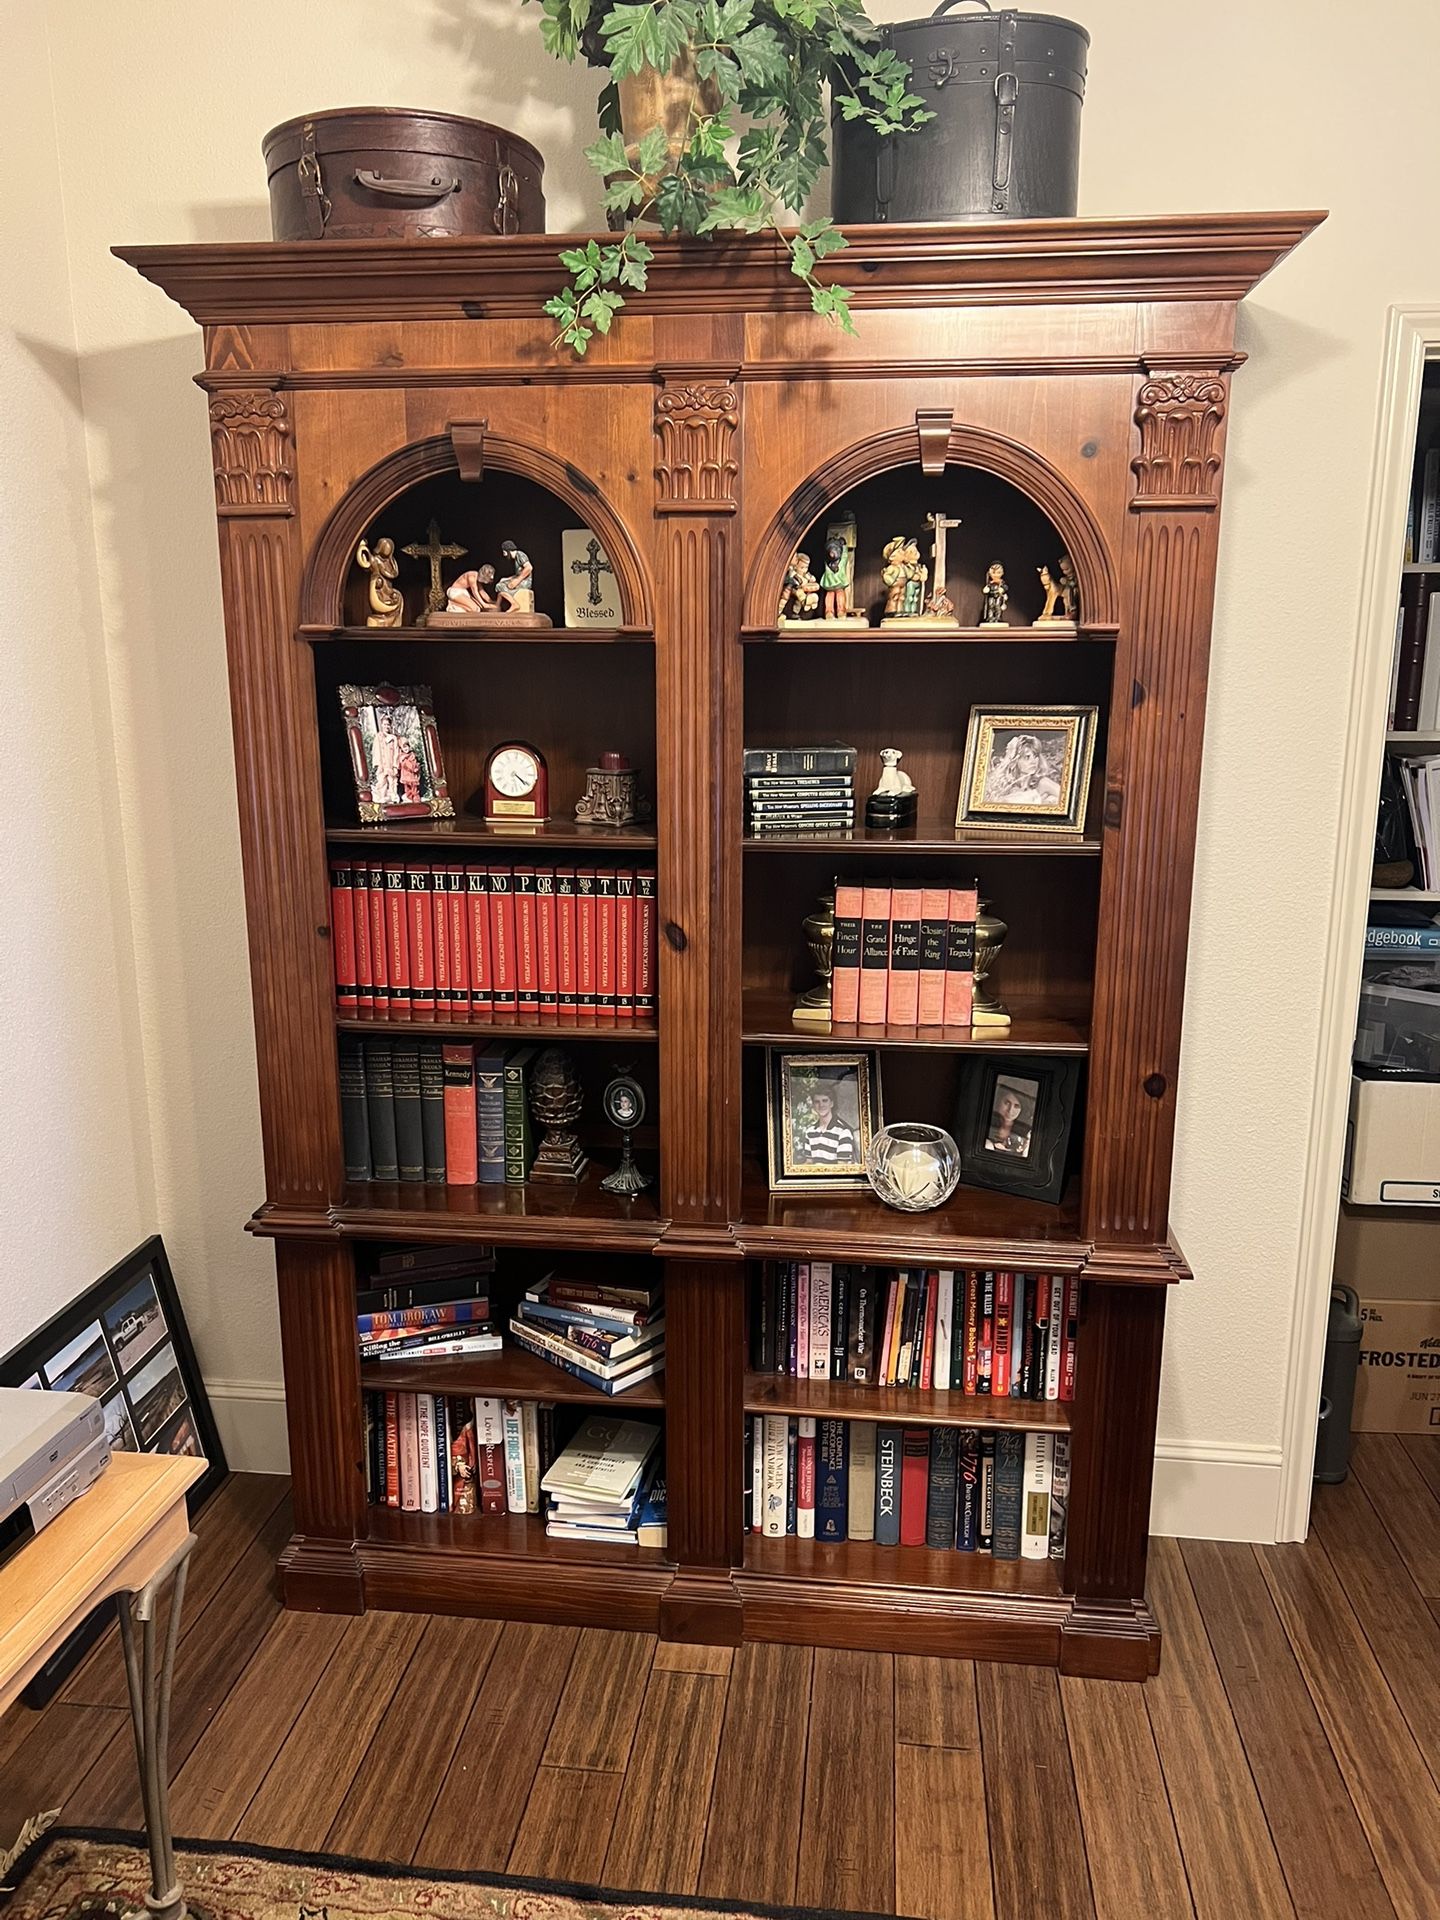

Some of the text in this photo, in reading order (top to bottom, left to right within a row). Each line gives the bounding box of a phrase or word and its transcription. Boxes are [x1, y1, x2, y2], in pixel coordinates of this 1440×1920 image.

[576, 606, 615, 618] Blessed
[337, 872, 346, 886] B
[388, 874, 402, 888] DE
[411, 875, 424, 890] FG
[435, 875, 444, 890] H
[469, 876, 484, 891] KL
[492, 877, 507, 891] NO
[521, 877, 530, 891] P
[538, 878, 552, 893] QR
[601, 880, 610, 894] T
[617, 880, 632, 895] UV
[836, 932, 859, 942] Finest
[922, 926, 946, 936] Closing
[950, 925, 974, 935] Triumph
[866, 935, 886, 944] Grand
[894, 935, 917, 944] Hinge
[837, 946, 856, 954] Hour
[864, 947, 888, 956] Alliance
[893, 946, 918, 956] of Fate
[925, 950, 941, 960] Ring
[949, 948, 973, 958] Tragedy
[446, 1070, 471, 1079] Kennedy
[860, 1289, 867, 1298] On
[985, 1282, 993, 1292] THE
[818, 1280, 830, 1336] AMERICA'S
[984, 1294, 993, 1315] KILLERS
[996, 1304, 1009, 1318] RED
[1069, 1291, 1078, 1316] KENNEDY
[374, 1309, 446, 1325] TOM BROKAW
[858, 1299, 867, 1342] Thermonuclear
[968, 1301, 976, 1326] Money
[1361, 1309, 1368, 1321] 5
[1051, 1324, 1059, 1338] YOUR
[364, 1343, 388, 1352] Killing
[581, 1332, 599, 1349] 1776
[968, 1327, 976, 1353] Bubble
[996, 1327, 1008, 1355] HANDED
[1066, 1353, 1074, 1374] O'REILLY
[1358, 1351, 1440, 1368] FROSTED
[1410, 1392, 1428, 1401] JUN
[388, 1400, 396, 1421] THE
[436, 1397, 446, 1457] NEVER GO BACK
[484, 1417, 494, 1437] LOVE
[822, 1421, 828, 1430] TO
[388, 1423, 397, 1467] AMATEUR
[420, 1407, 430, 1469] THE HOPE QUOTIENT
[507, 1419, 520, 1461] LIFE FORCE
[486, 1444, 496, 1477] RESPECT
[767, 1420, 776, 1489] BIBLE HANDBOOK
[1035, 1435, 1046, 1485] MILLENNIUM
[776, 1459, 784, 1490] UNGER'S
[961, 1453, 977, 1484] 1776
[880, 1440, 894, 1517] STEINBECK
[515, 1478, 524, 1501] ROBBINS
[986, 1501, 992, 1509] OF
